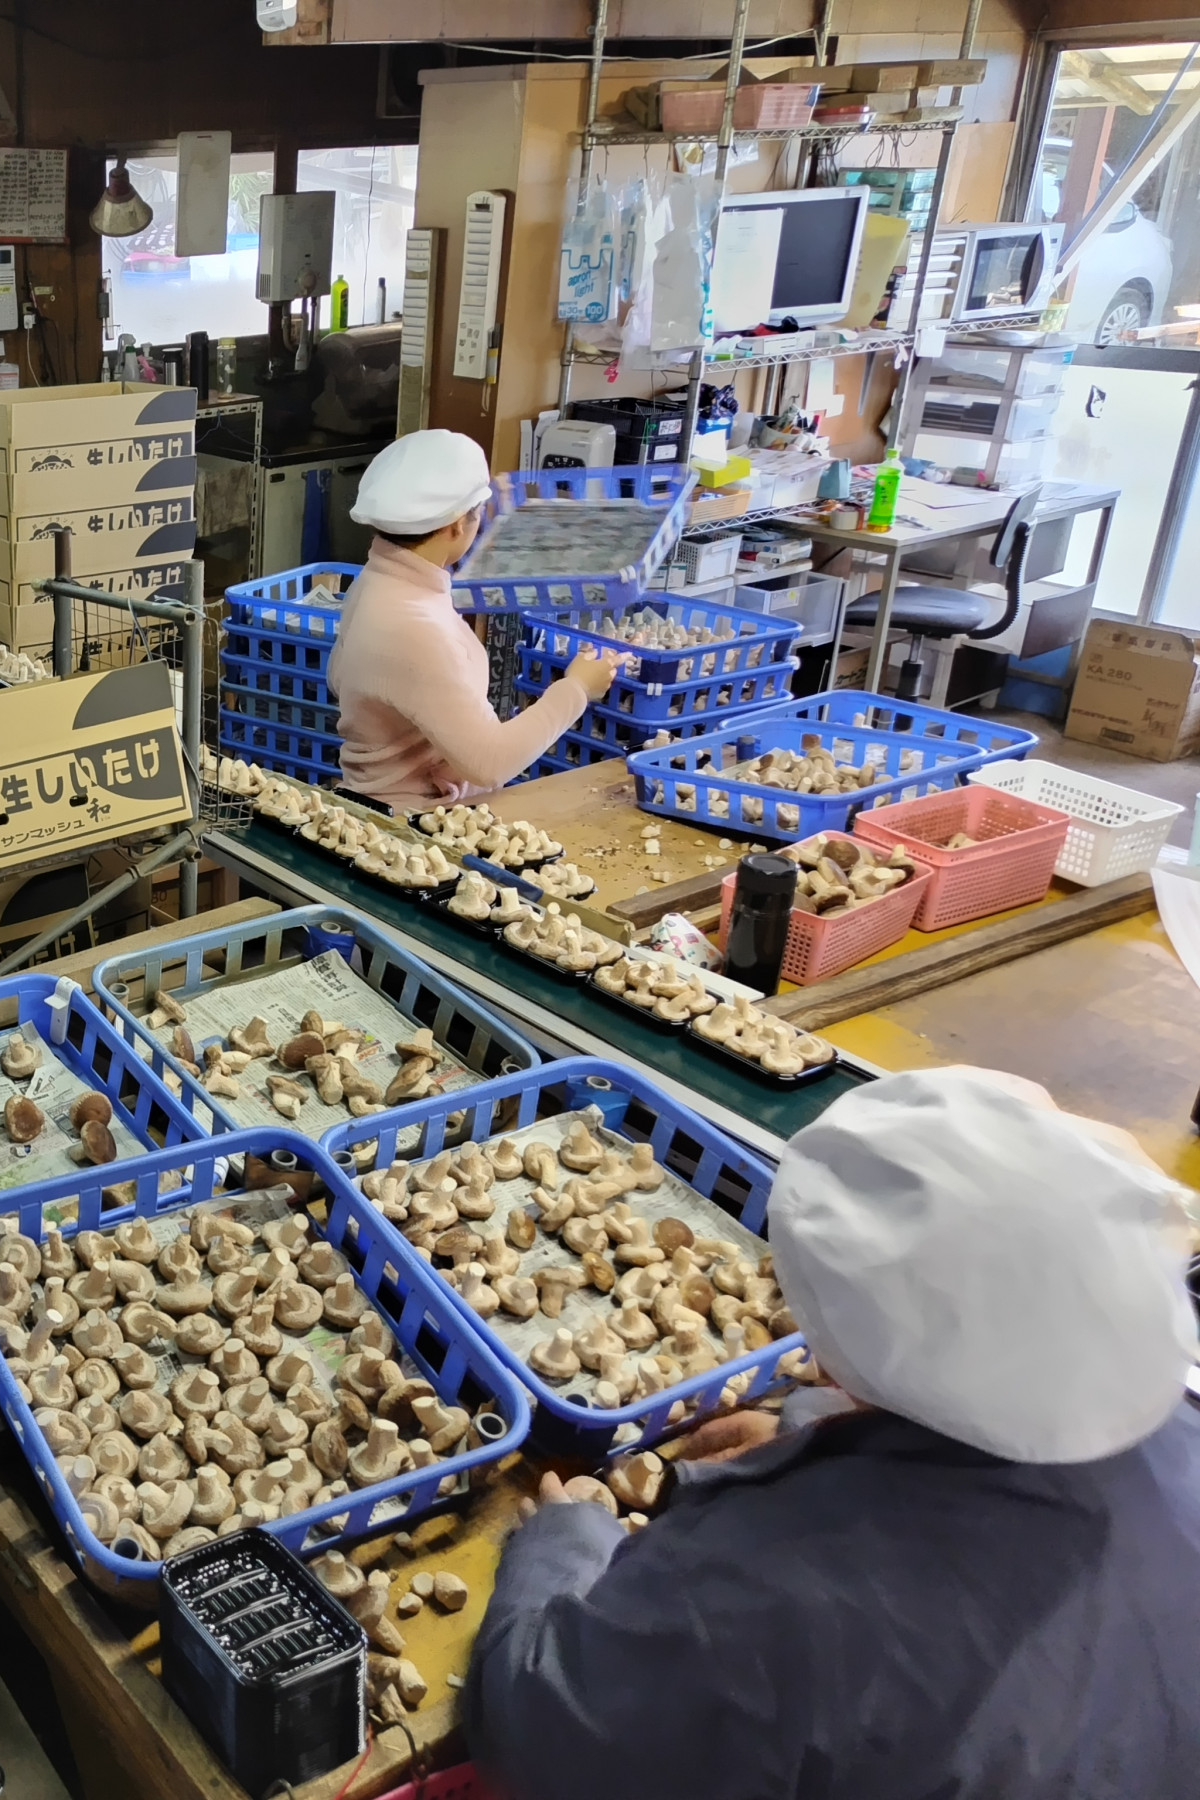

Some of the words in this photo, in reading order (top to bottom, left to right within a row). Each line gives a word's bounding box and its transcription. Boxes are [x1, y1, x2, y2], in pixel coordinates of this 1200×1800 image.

[1087, 664, 1104, 675] KA
[1107, 668, 1132, 681] 280
[0, 738, 160, 815] 生しいたけ
[0, 819, 85, 847] サンマッシュ
[86, 797, 111, 823] 和
